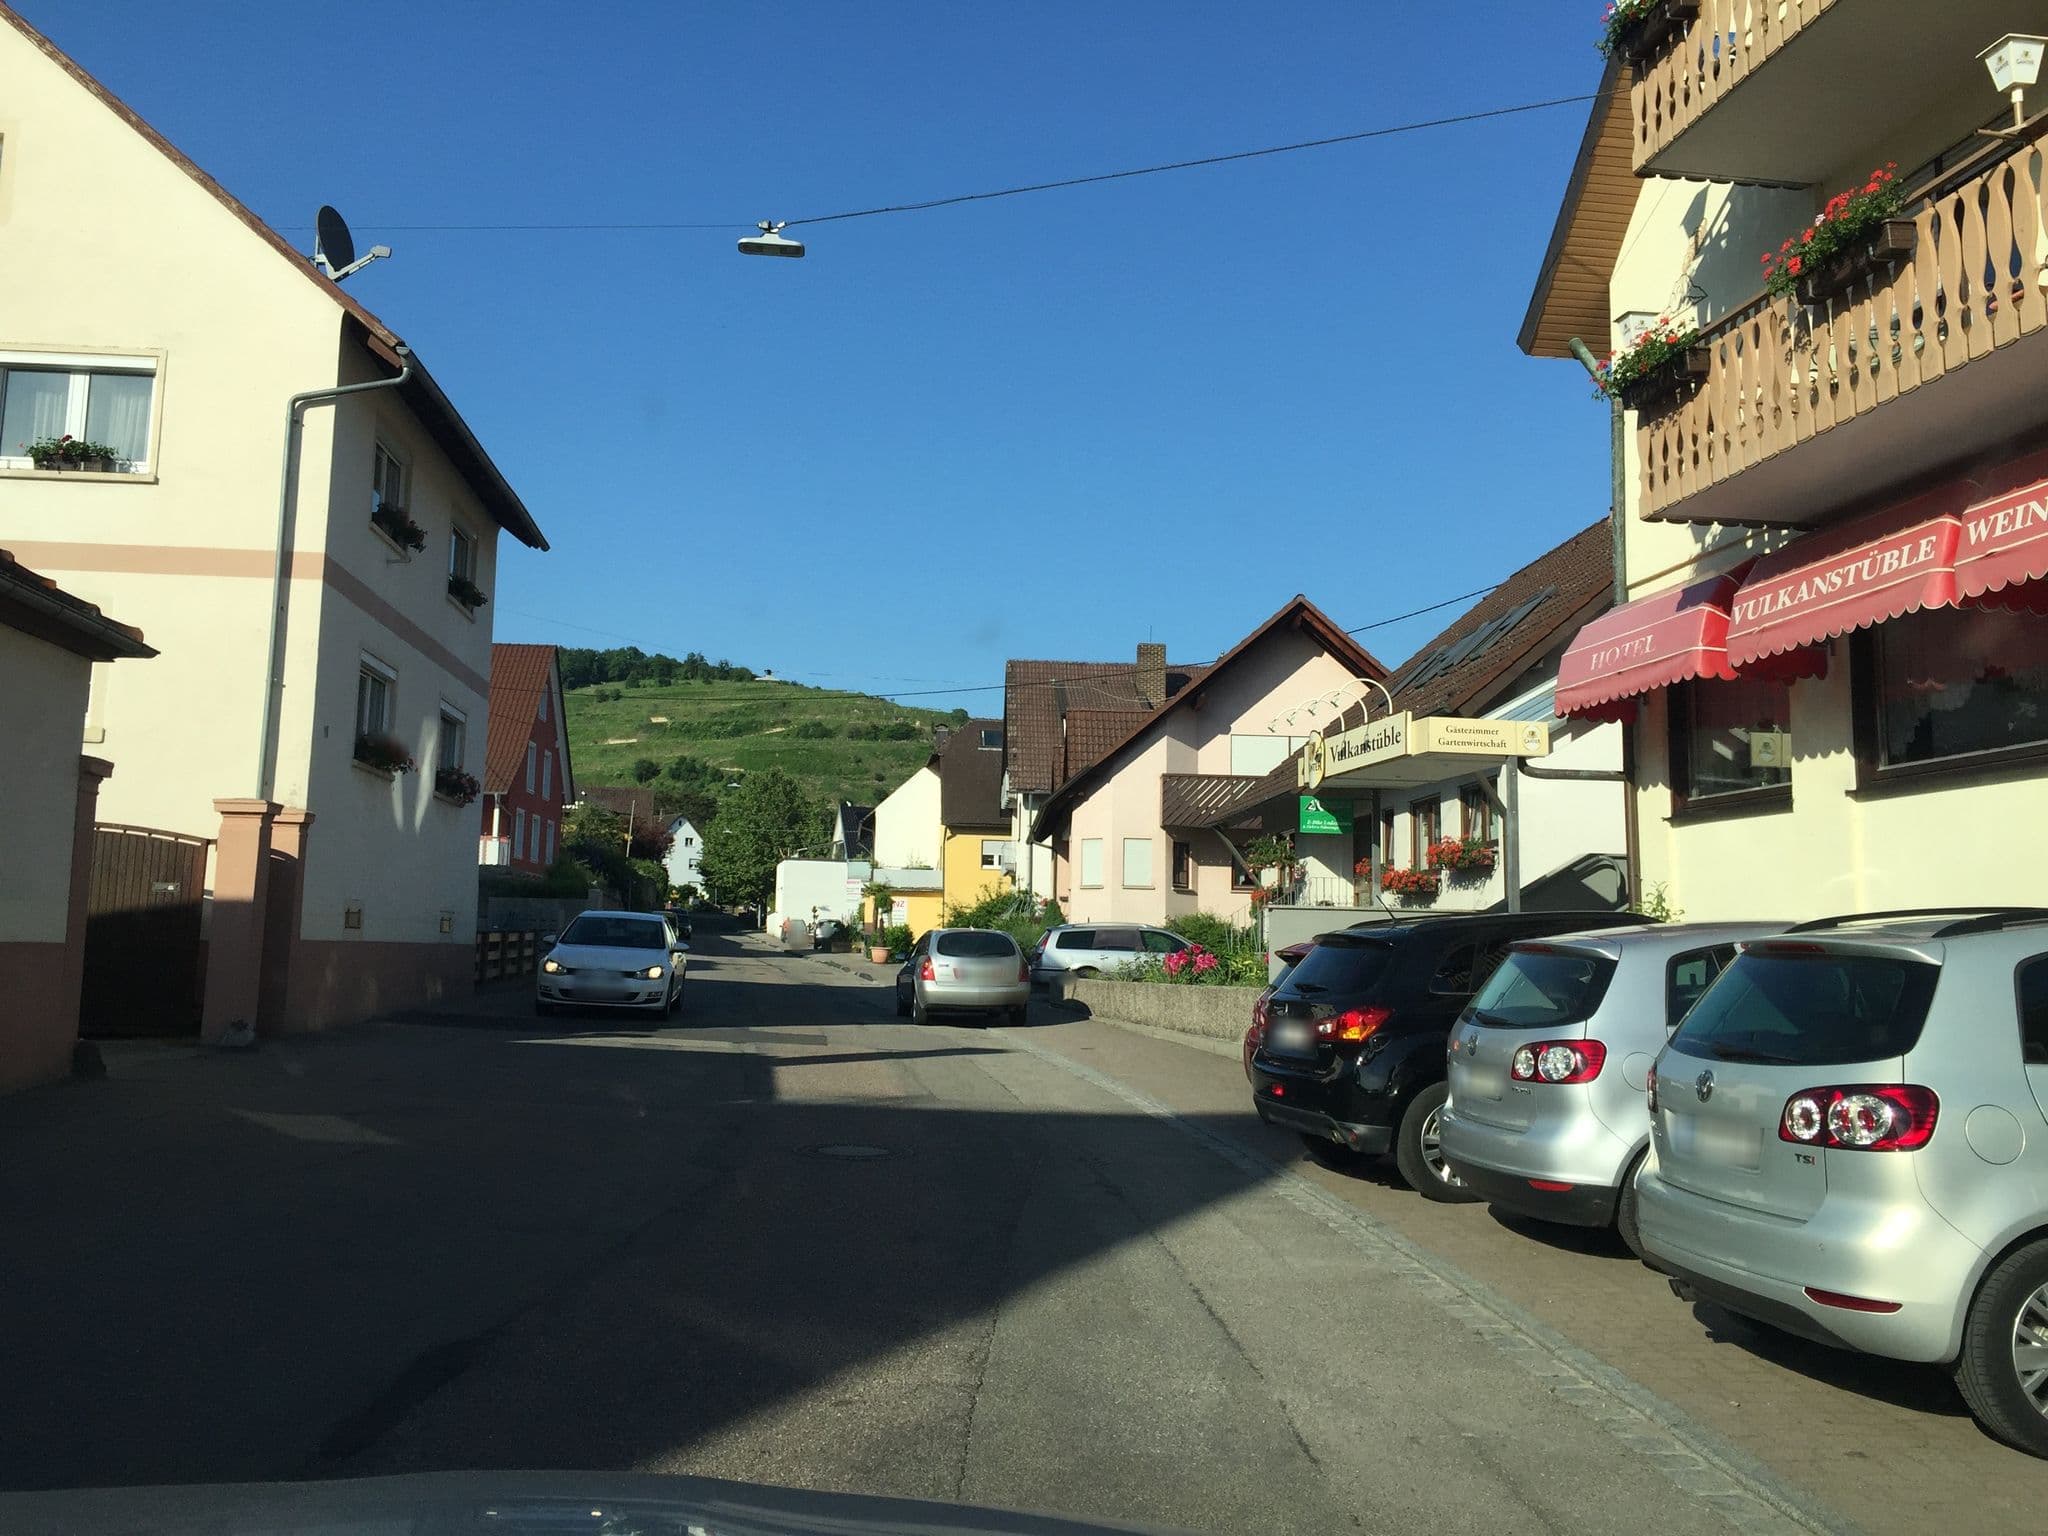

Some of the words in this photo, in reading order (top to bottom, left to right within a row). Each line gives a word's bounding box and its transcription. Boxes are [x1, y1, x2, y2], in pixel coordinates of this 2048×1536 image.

[1966, 496, 2048, 546] WEIN
[1731, 535, 1937, 626] VULKANSTÜBLE
[1589, 634, 1657, 671] HOTEL
[1329, 725, 1402, 763] Vulkanstüble
[1438, 737, 1507, 748] Gartenwirtschaft
[1445, 724, 1500, 736] Gästezimmer
[1794, 1153, 1815, 1165] TSI
